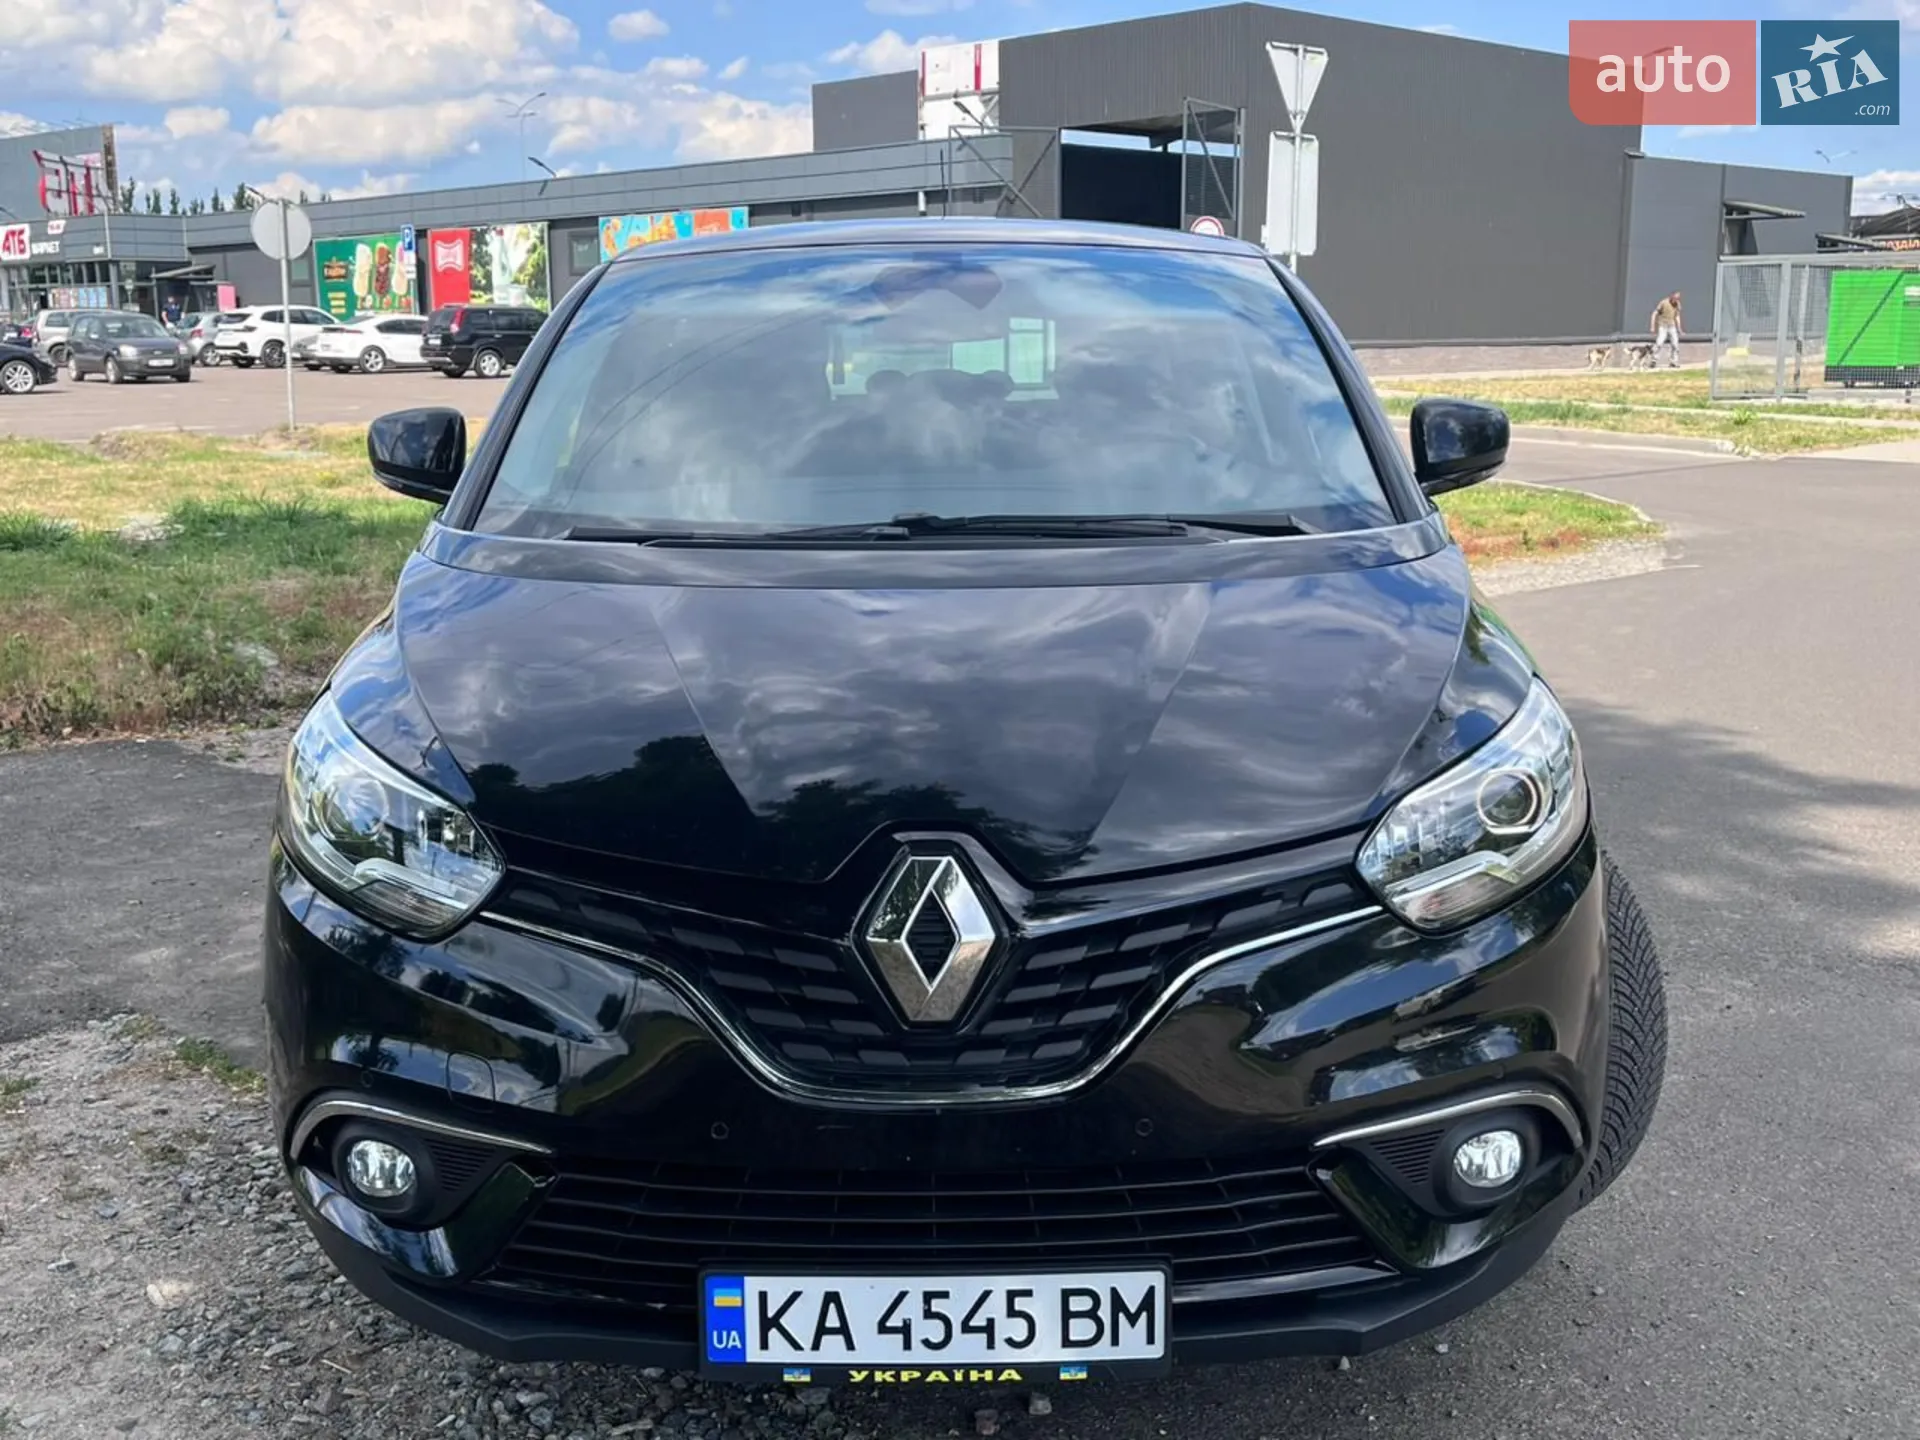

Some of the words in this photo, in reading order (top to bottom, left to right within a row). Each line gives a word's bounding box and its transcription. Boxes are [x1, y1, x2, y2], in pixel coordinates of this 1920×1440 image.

[2, 228, 26, 255] АТБ
[757, 1289, 856, 1352] KA
[877, 1288, 1037, 1351] 4545
[1060, 1284, 1156, 1348] BM
[712, 1331, 742, 1350] UA
[848, 1367, 1024, 1383] УКРАЇНА
